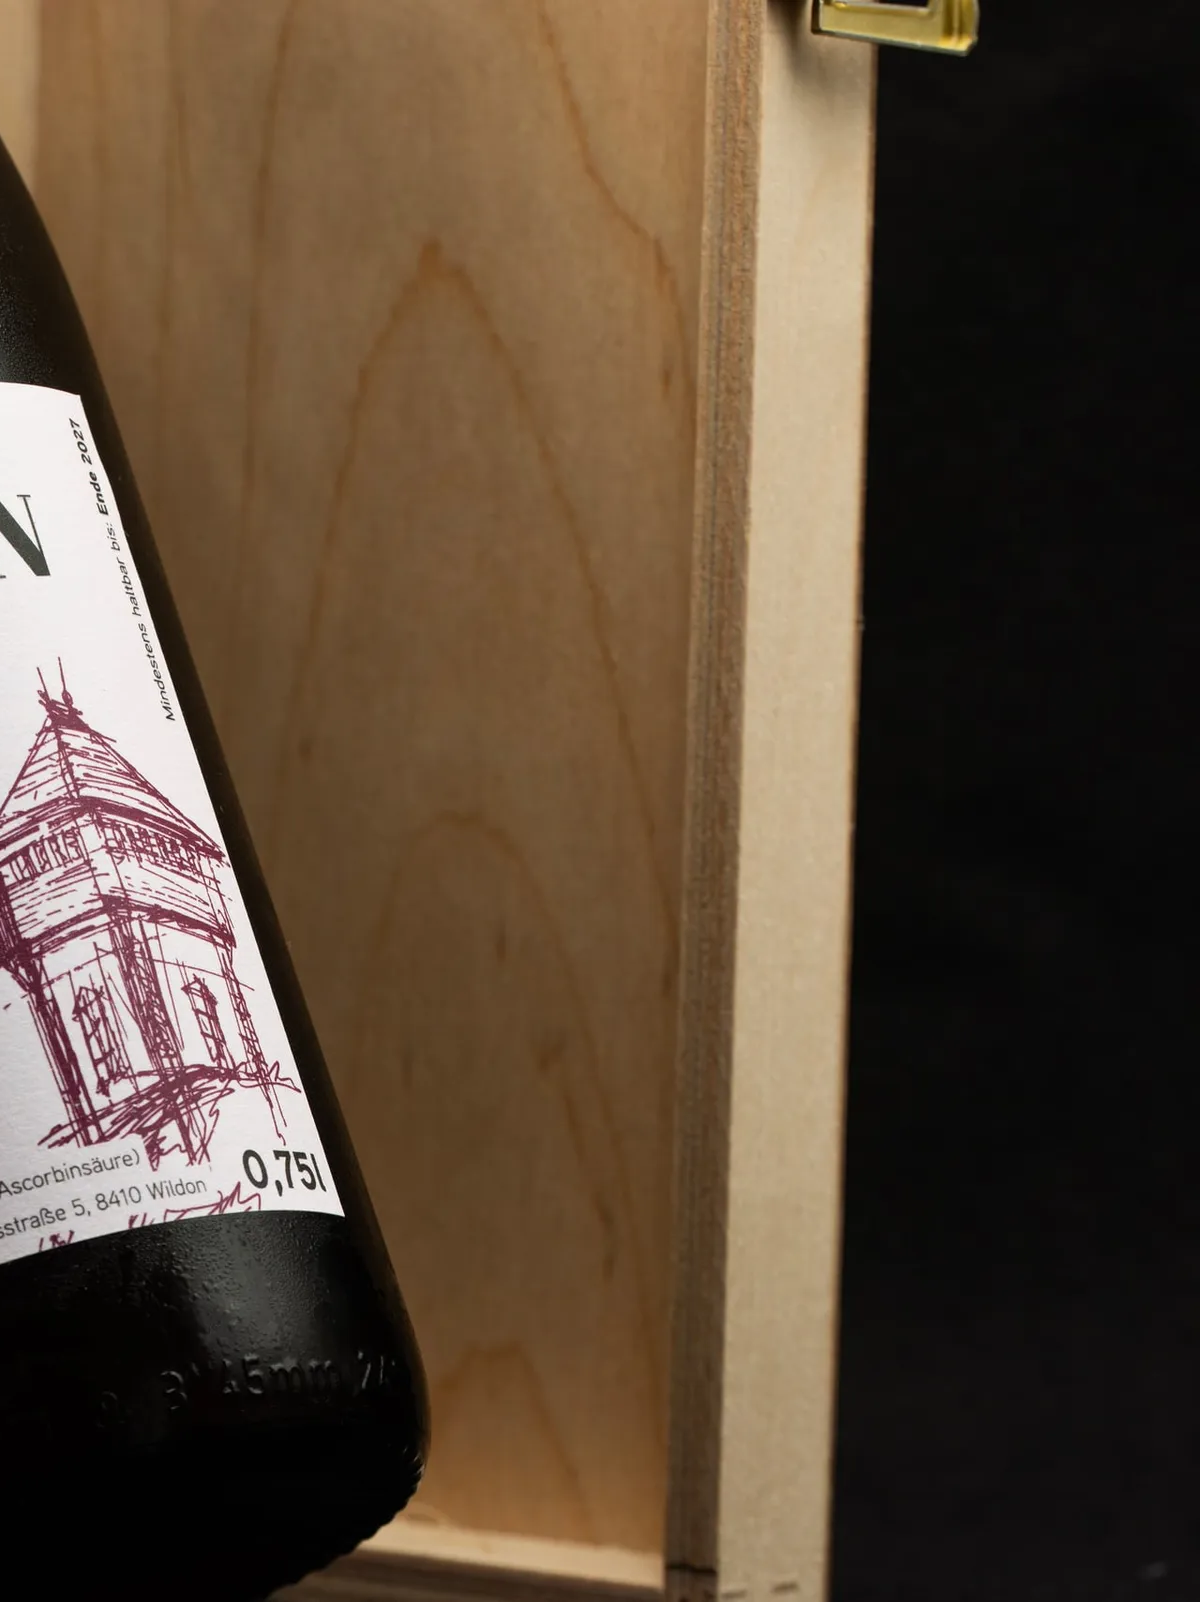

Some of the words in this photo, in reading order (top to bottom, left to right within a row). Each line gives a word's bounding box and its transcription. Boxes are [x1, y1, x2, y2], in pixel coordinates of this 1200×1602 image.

[69, 418, 93, 465] 2027
[89, 471, 109, 516] Ende
[107, 522, 121, 552] bis:
[117, 557, 142, 617] haltbar
[138, 622, 176, 721] Mindestens
[71, 1198, 92, 1218] 5,
[96, 1189, 142, 1213] 8410
[146, 1177, 208, 1202] Wildon
